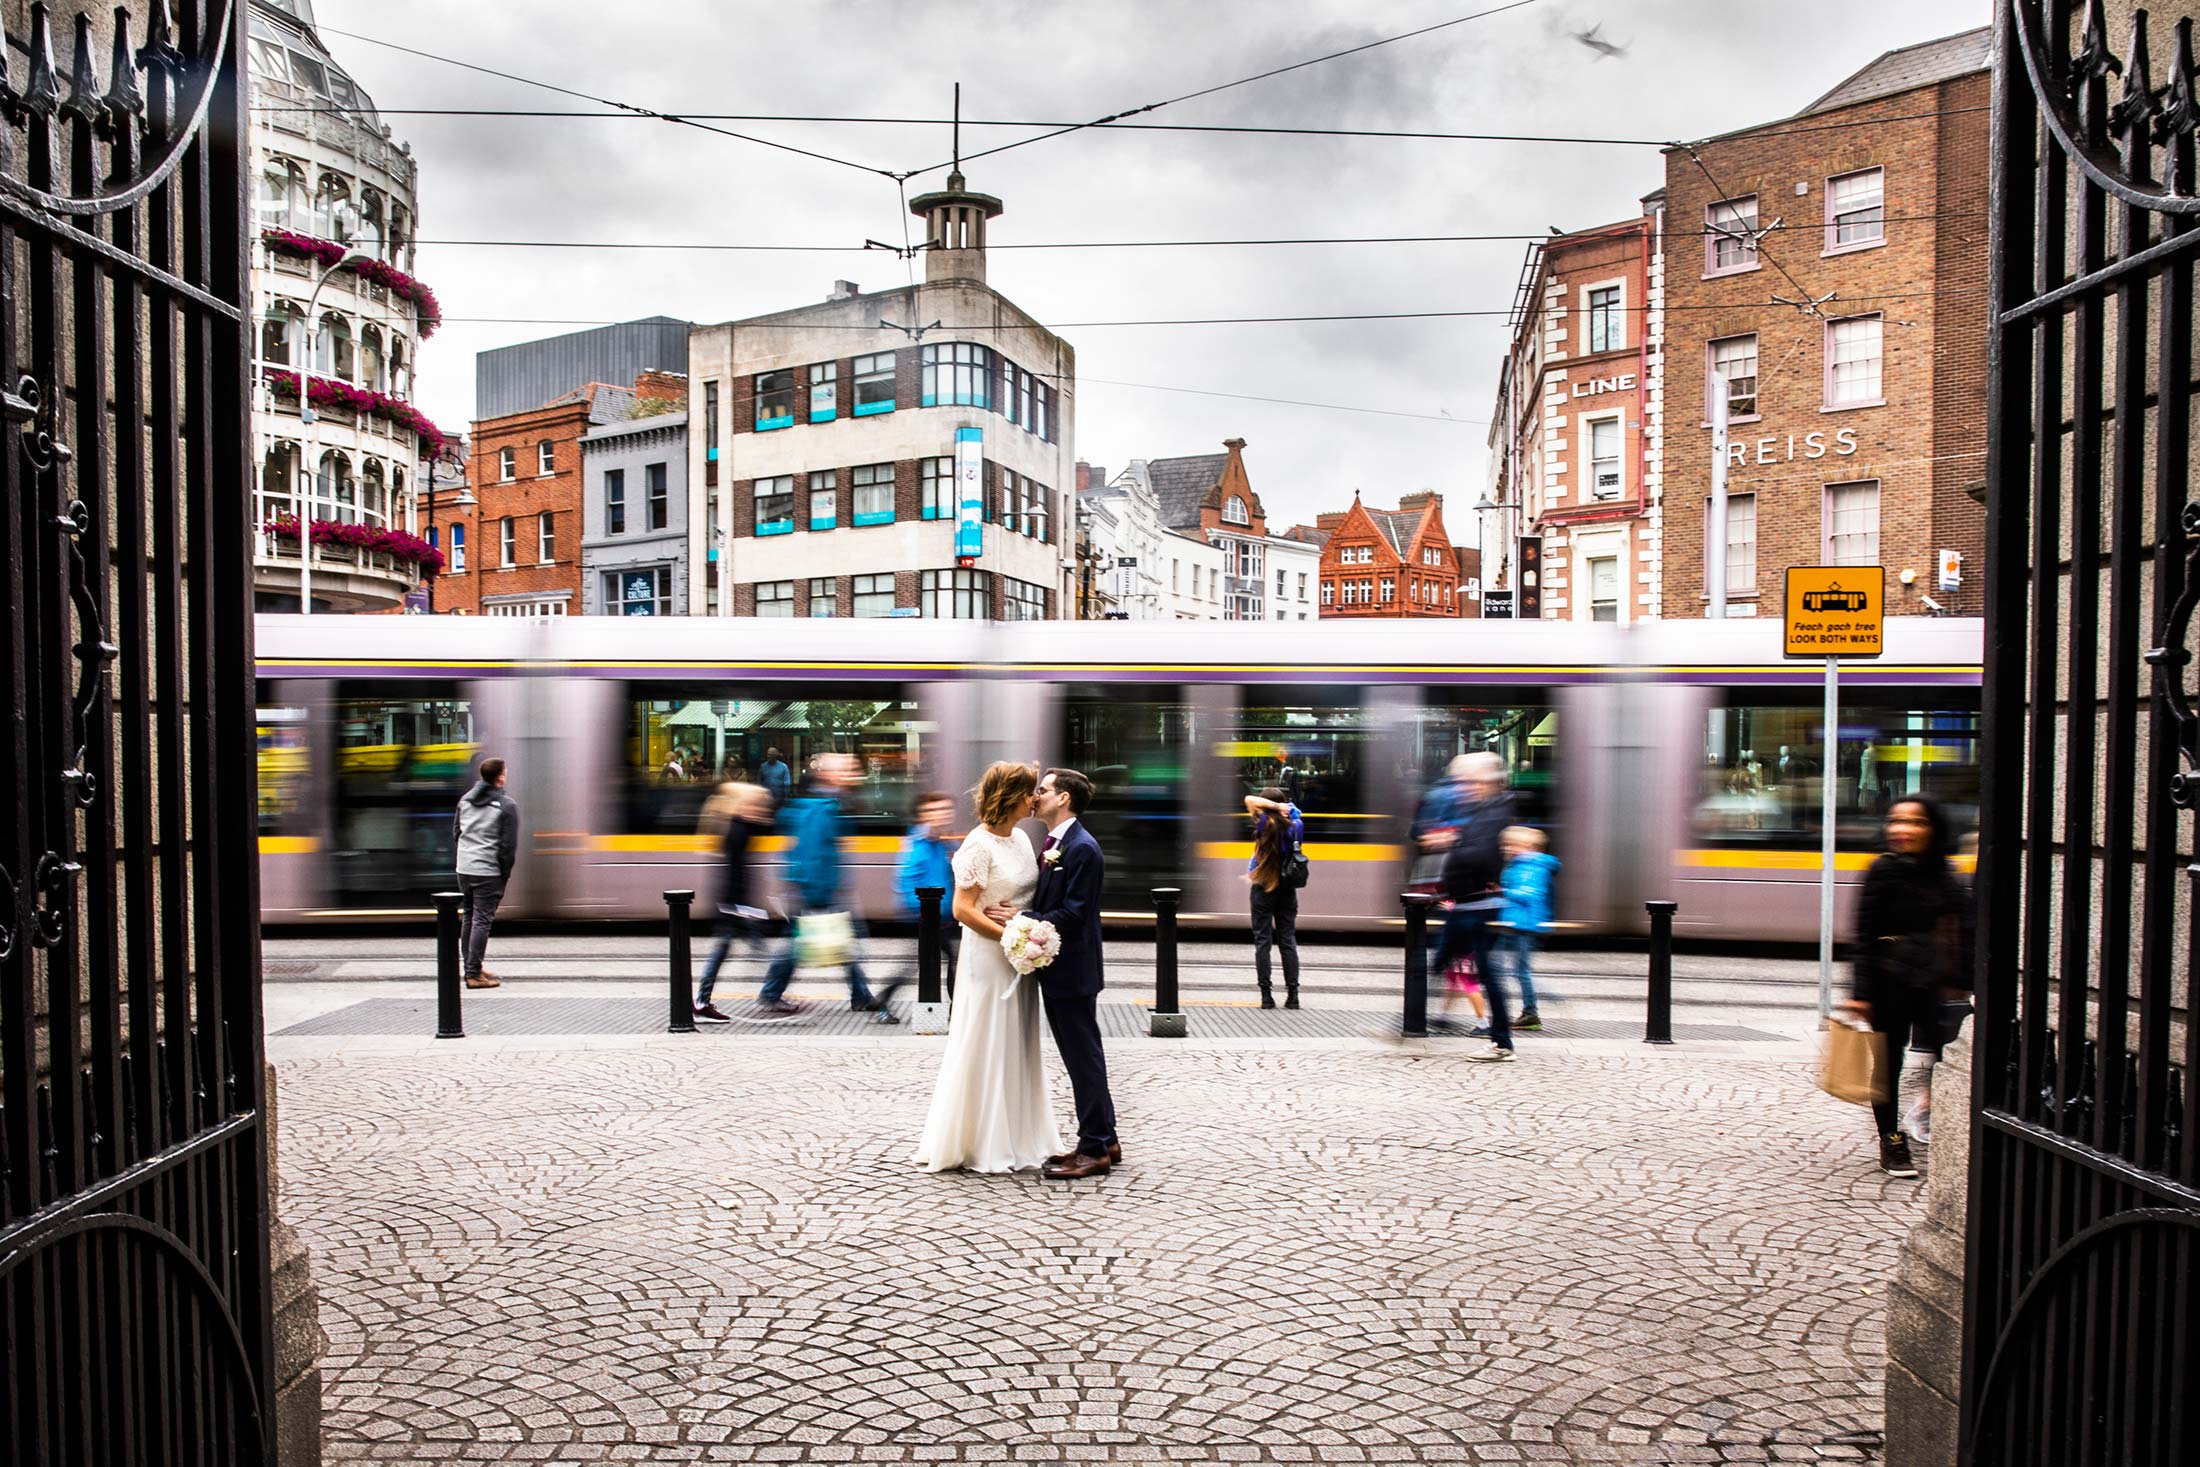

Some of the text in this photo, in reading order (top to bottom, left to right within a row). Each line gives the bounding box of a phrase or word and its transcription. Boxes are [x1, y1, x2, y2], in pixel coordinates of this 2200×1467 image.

[1572, 373, 1637, 398] LINE
[1727, 428, 1858, 468] REISS
[1826, 622, 1851, 632] gach
[1855, 622, 1876, 631] treo
[1789, 634, 1879, 643] LOOK BOTH WAYS
